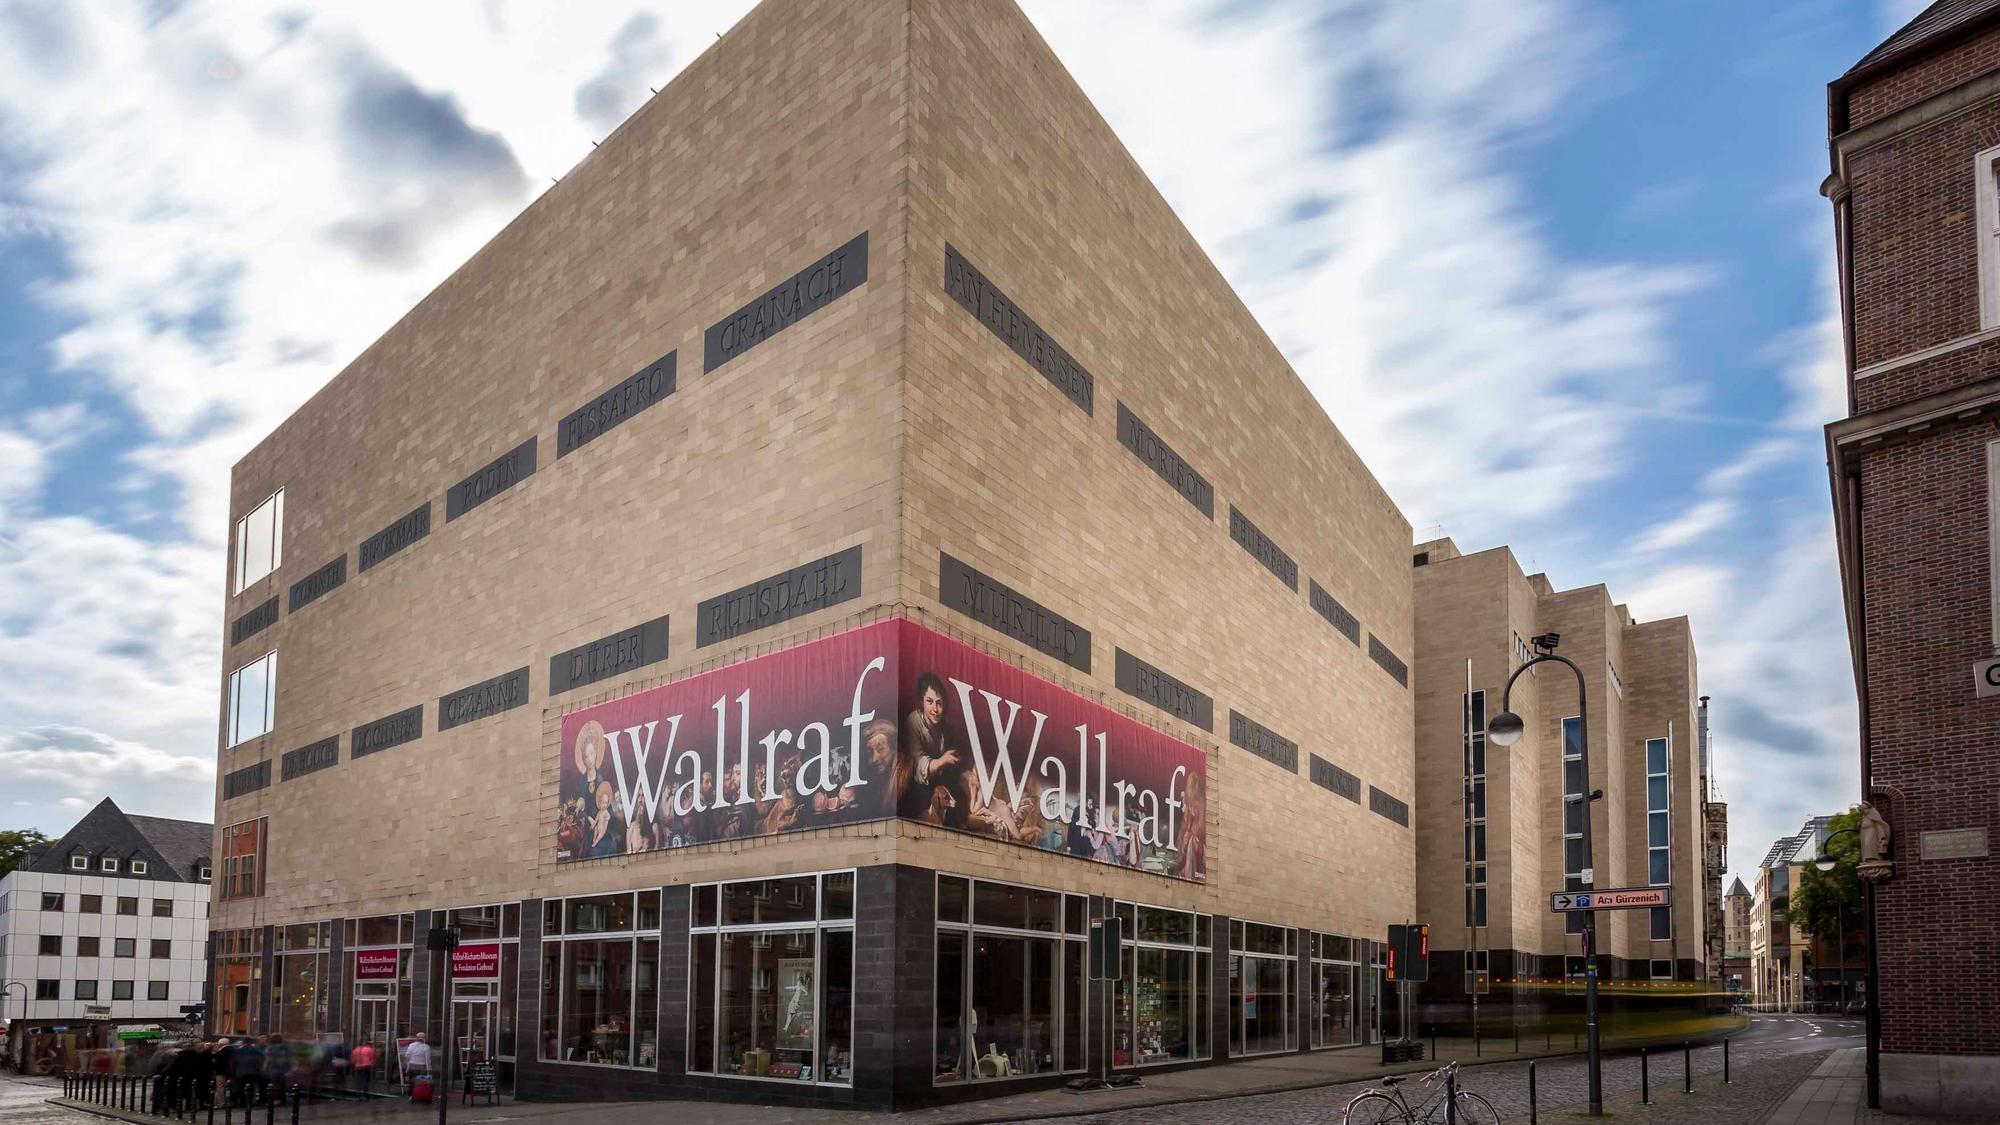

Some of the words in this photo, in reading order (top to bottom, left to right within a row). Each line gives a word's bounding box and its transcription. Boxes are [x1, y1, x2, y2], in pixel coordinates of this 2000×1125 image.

[720, 254, 847, 352] CRANACH
[945, 252, 983, 312] VAN
[991, 292, 1093, 408] HEMESSEN
[567, 367, 663, 447] PISSARRO
[463, 454, 519, 508] RODIN
[1129, 419, 1206, 505] MORISOT
[709, 561, 847, 636] RUISDAEL
[961, 573, 1077, 656] MURILLO
[570, 634, 639, 682] DÜRER
[1137, 667, 1197, 718] BRUYN
[604, 656, 885, 828] Wallraf
[949, 677, 1186, 852] Wallraf
[1615, 893, 1660, 904] Gürzenich
